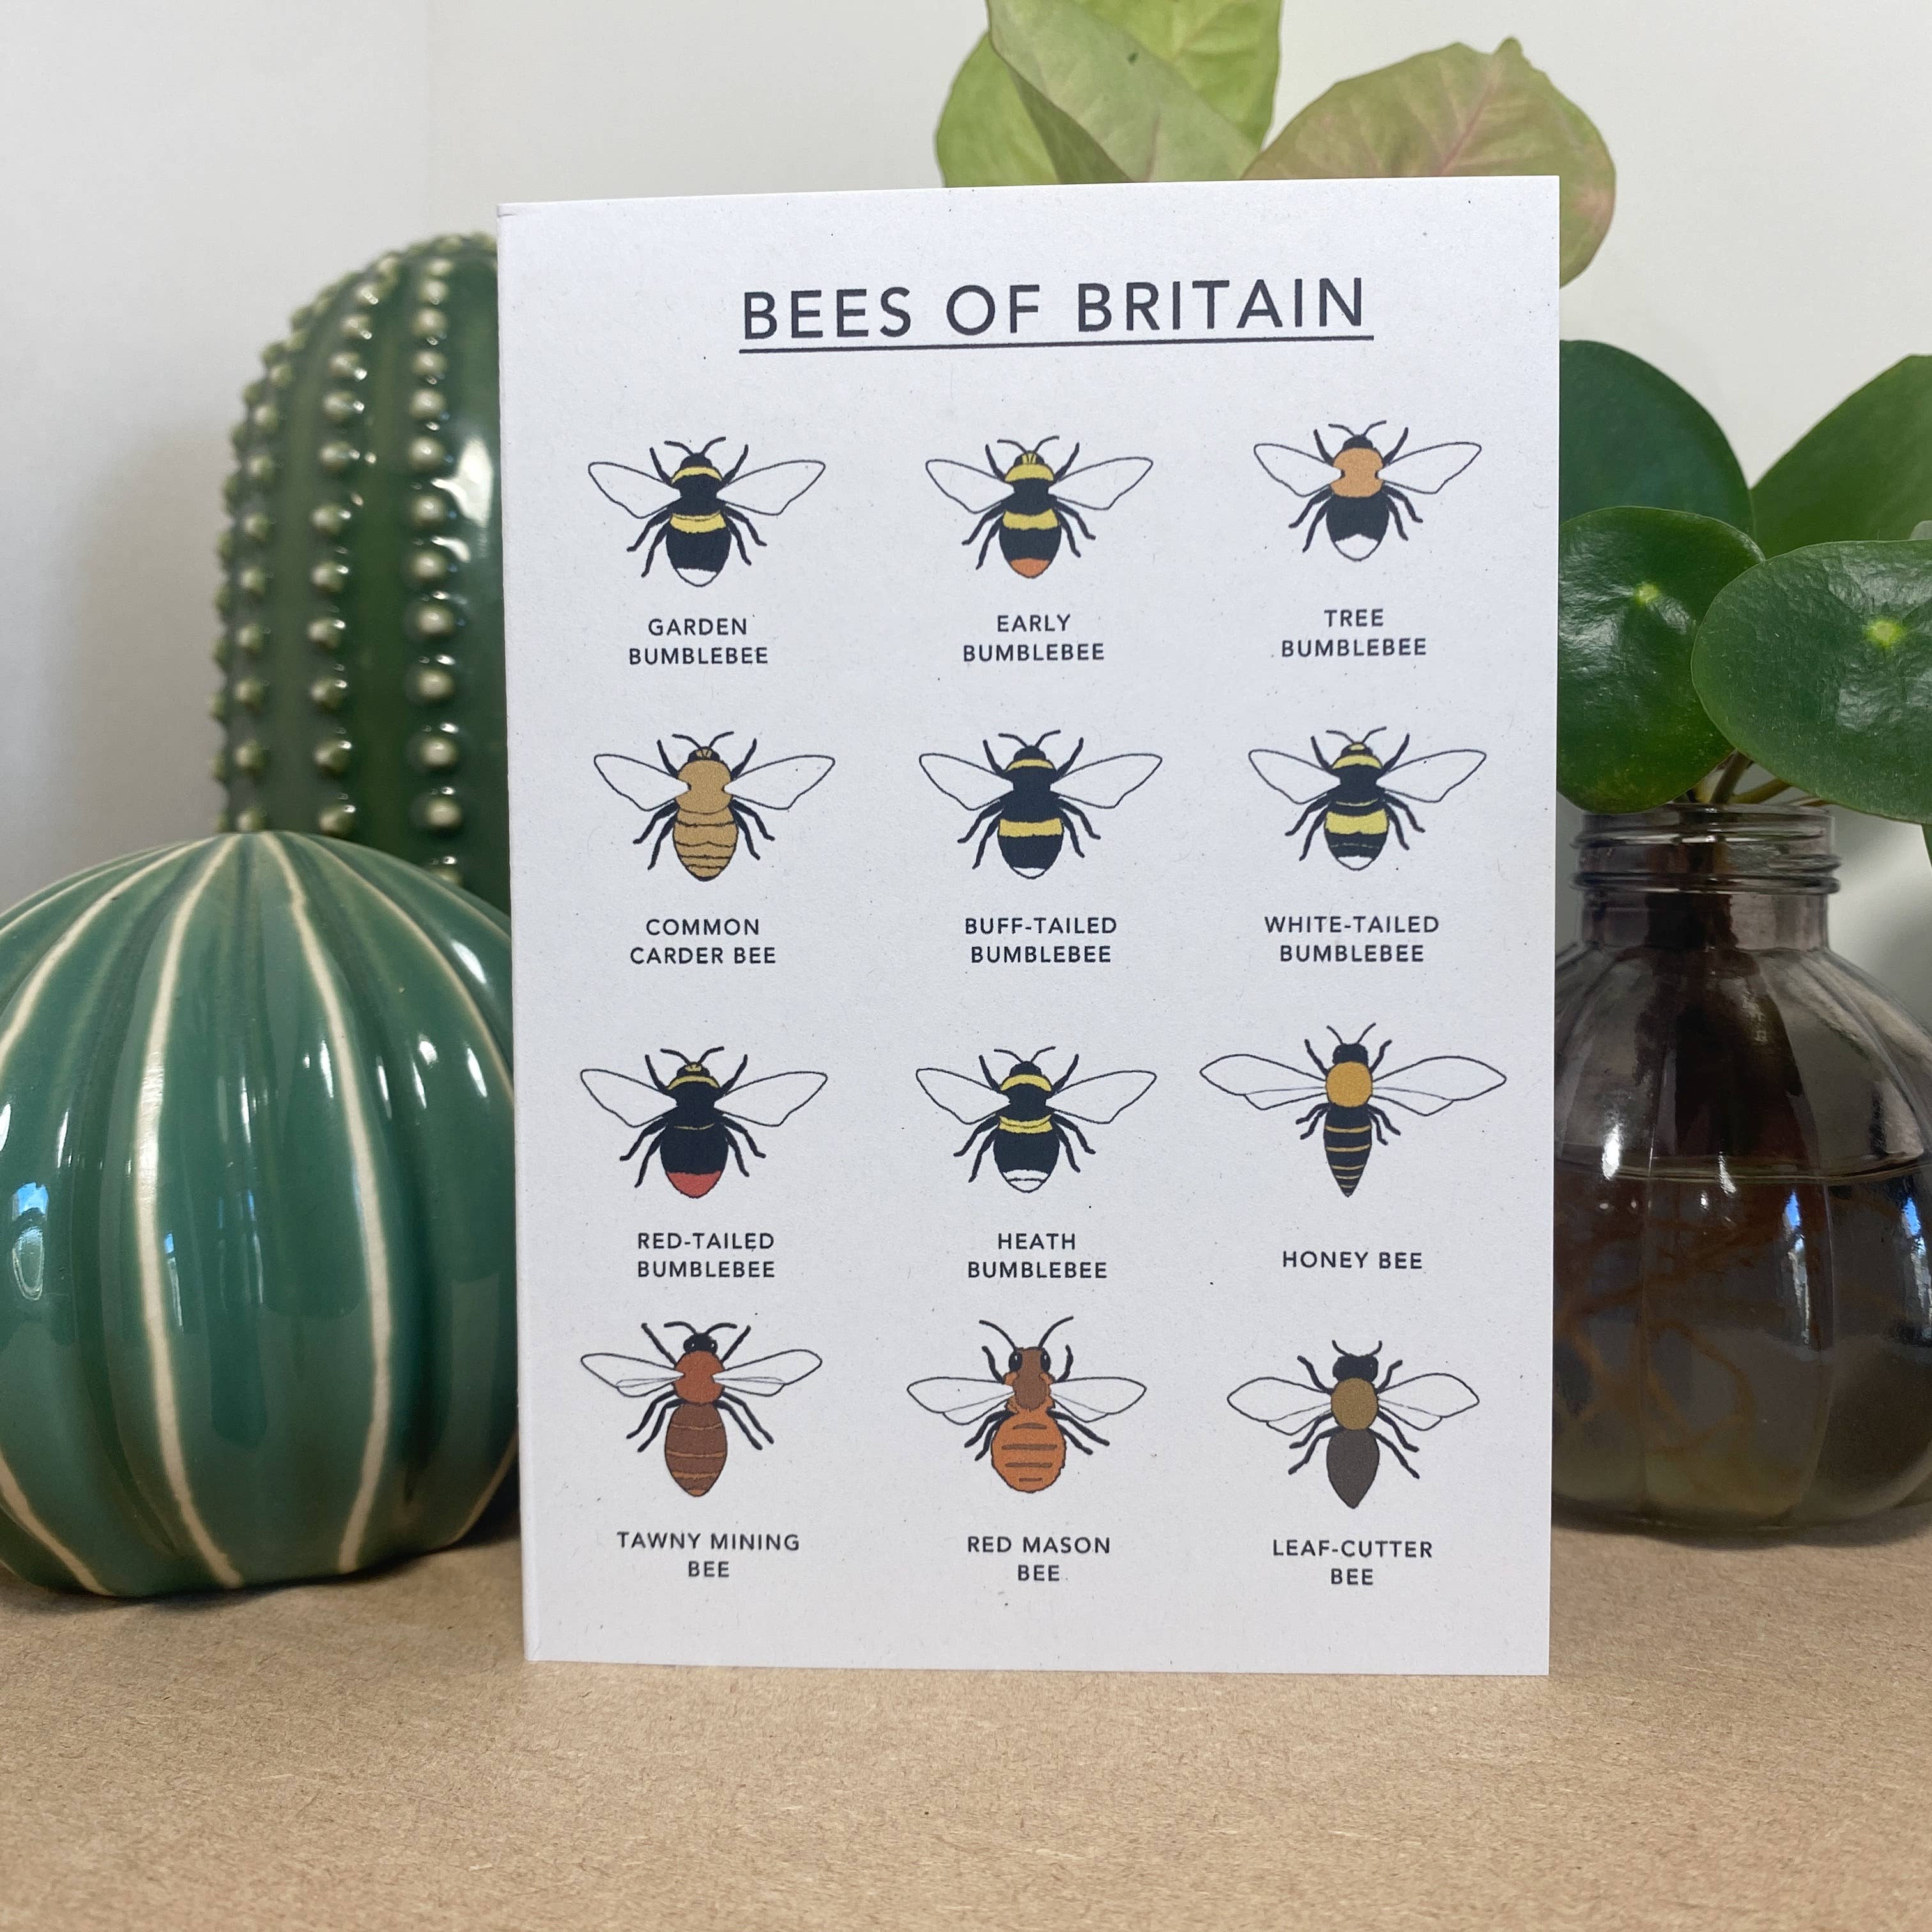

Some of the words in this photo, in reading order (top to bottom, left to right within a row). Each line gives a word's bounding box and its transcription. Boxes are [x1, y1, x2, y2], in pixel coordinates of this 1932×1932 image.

[744, 287, 911, 339] BEES
[946, 284, 1040, 336] OF
[1078, 277, 1361, 332] BRITAIN
[648, 618, 746, 636] GARDEN
[997, 614, 1070, 632] EARLY
[1324, 609, 1383, 627] TREE
[629, 647, 768, 665] BUMBLEBEE
[963, 643, 1104, 662] BUMBLEBEE
[1282, 638, 1426, 657] BUMBLEBEE
[646, 918, 759, 936] COMMON
[965, 917, 1117, 935] BUFF-TAILED
[1264, 916, 1439, 933] WHITE-TAILED
[630, 947, 723, 965] CARDER
[734, 947, 776, 964] BEE
[971, 945, 1111, 963] BUMBLEBEE
[1280, 944, 1423, 962] BUMBLEBEE
[638, 1232, 774, 1250] RED-TAILED
[998, 1232, 1075, 1250] HEATH
[1283, 1250, 1368, 1268] HONEY
[1379, 1252, 1422, 1269] BEE
[638, 1261, 775, 1278] BUMBLEBEE
[968, 1261, 1107, 1278] BUMBLEBEE
[617, 1531, 701, 1549] TAWNY
[710, 1533, 799, 1551] MINING
[968, 1536, 1012, 1552] RED
[1023, 1537, 1110, 1554] MASON
[1273, 1539, 1432, 1558] LEAF-CUTTER
[688, 1561, 729, 1577] BEE
[1018, 1565, 1060, 1581] BEE
[1331, 1568, 1373, 1586] BEE
